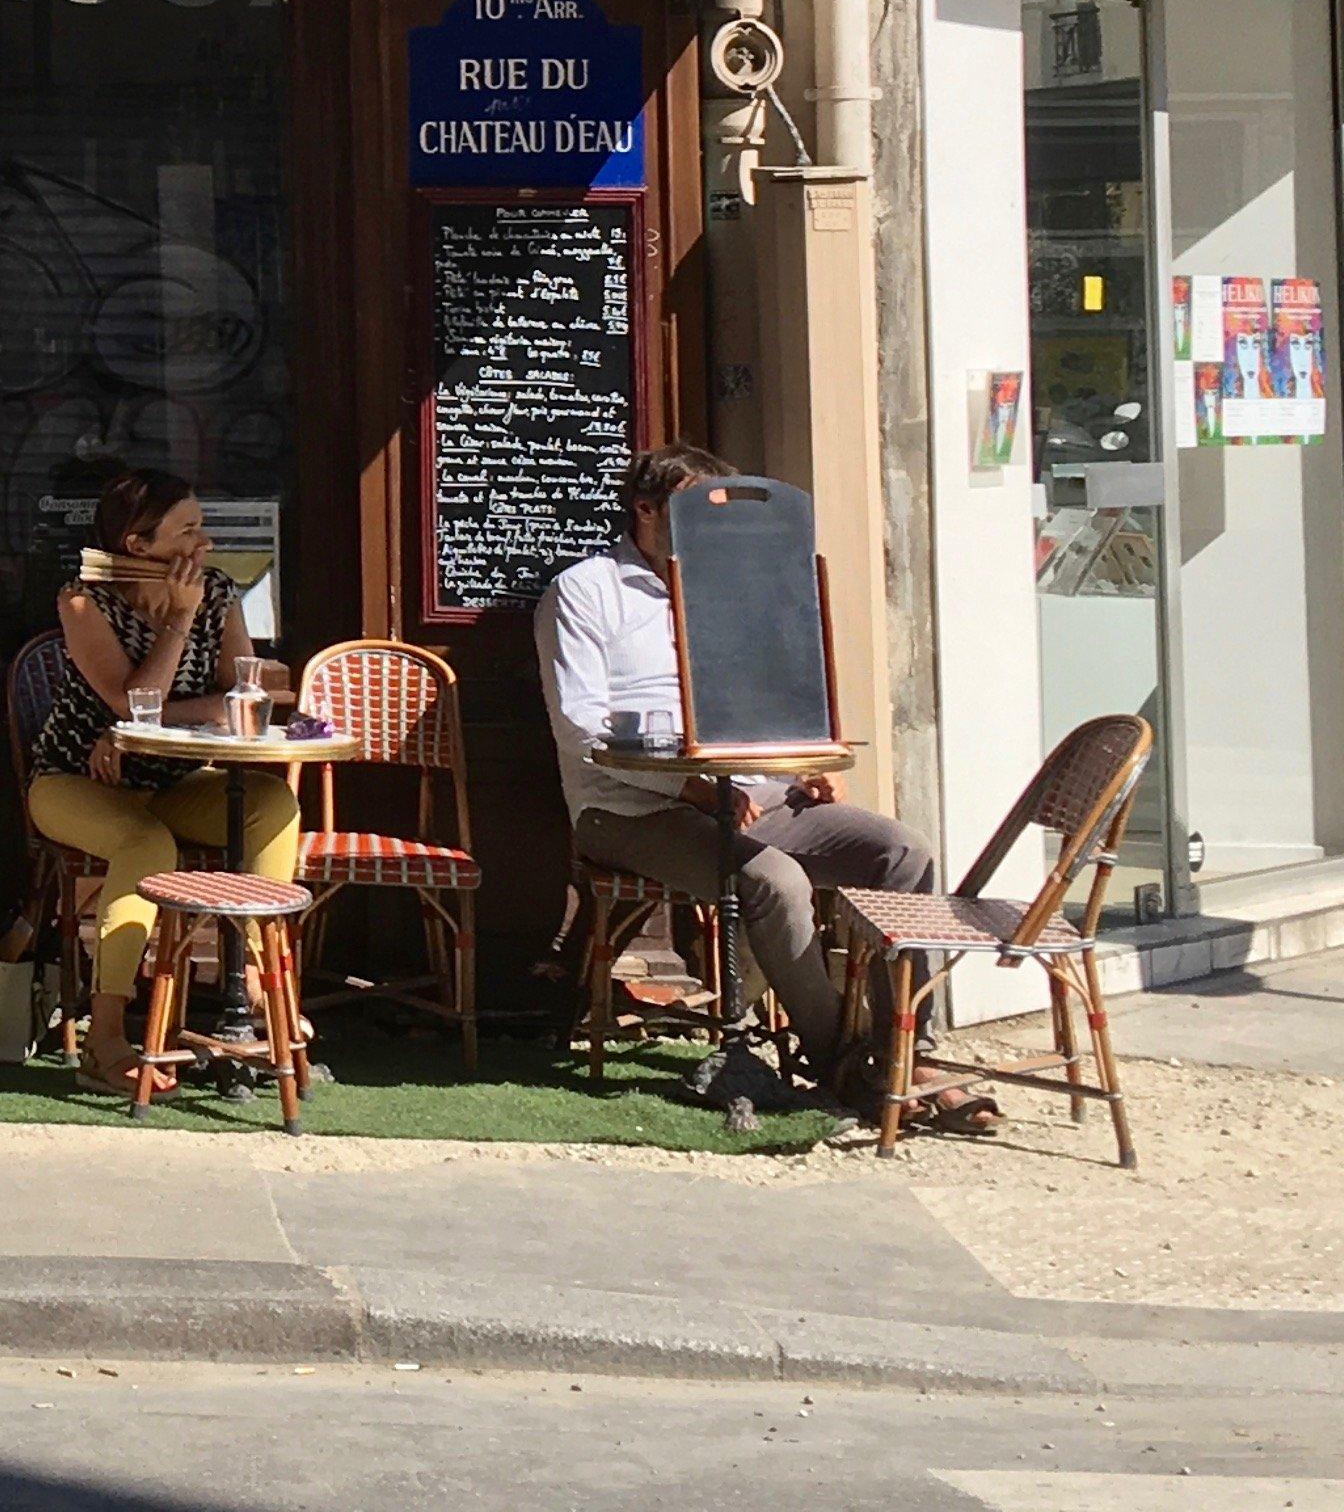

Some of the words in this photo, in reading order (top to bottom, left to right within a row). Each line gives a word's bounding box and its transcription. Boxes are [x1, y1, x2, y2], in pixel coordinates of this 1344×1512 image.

[459, 58, 528, 90] RUE
[541, 58, 589, 90] DU
[419, 120, 545, 154] CHATEAU
[555, 112, 633, 154] D'EAU
